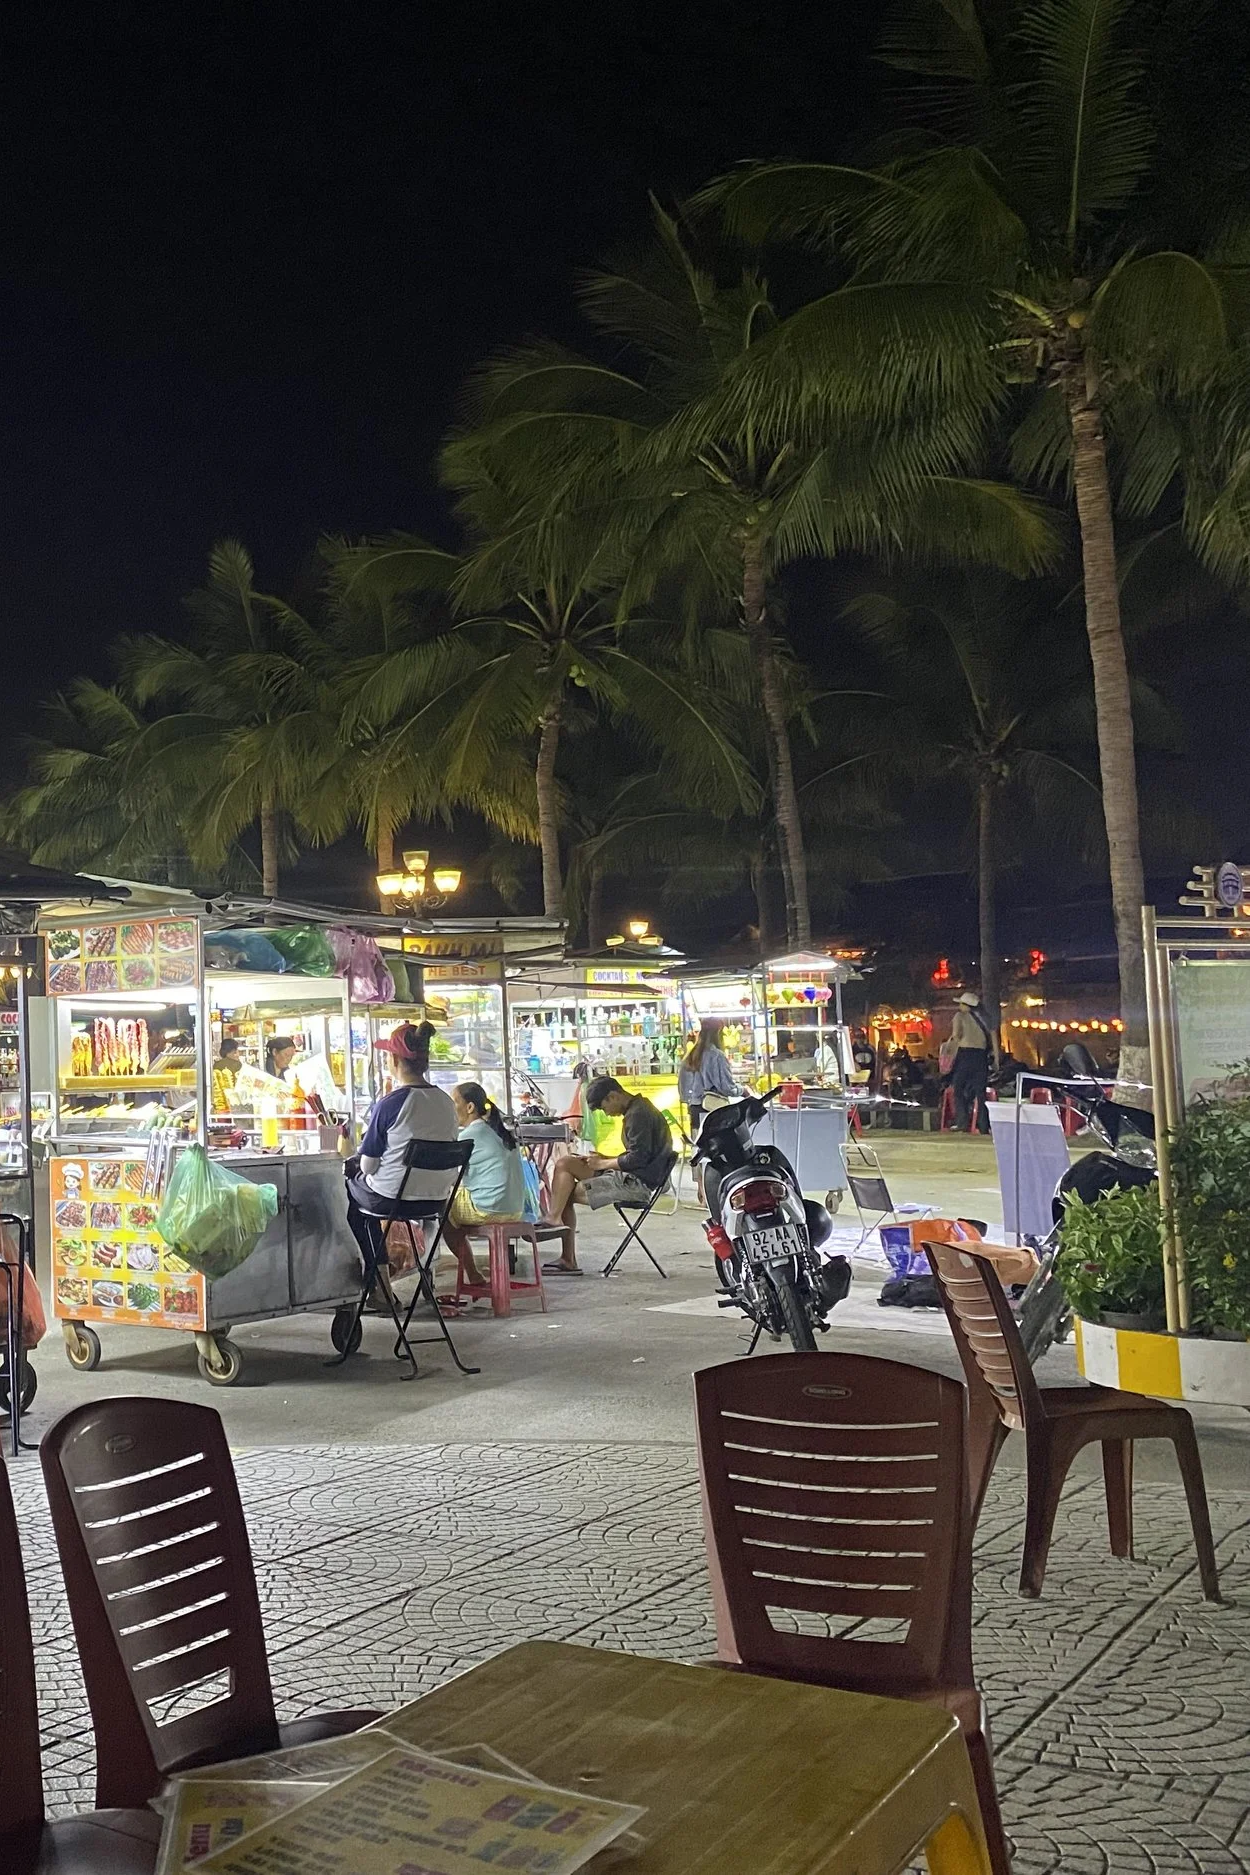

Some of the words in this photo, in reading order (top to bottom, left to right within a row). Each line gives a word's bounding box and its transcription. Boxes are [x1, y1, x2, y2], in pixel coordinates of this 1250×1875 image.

[428, 967, 447, 977] HE
[452, 965, 486, 976] BEST
[753, 1240, 798, 1261] 454.61
